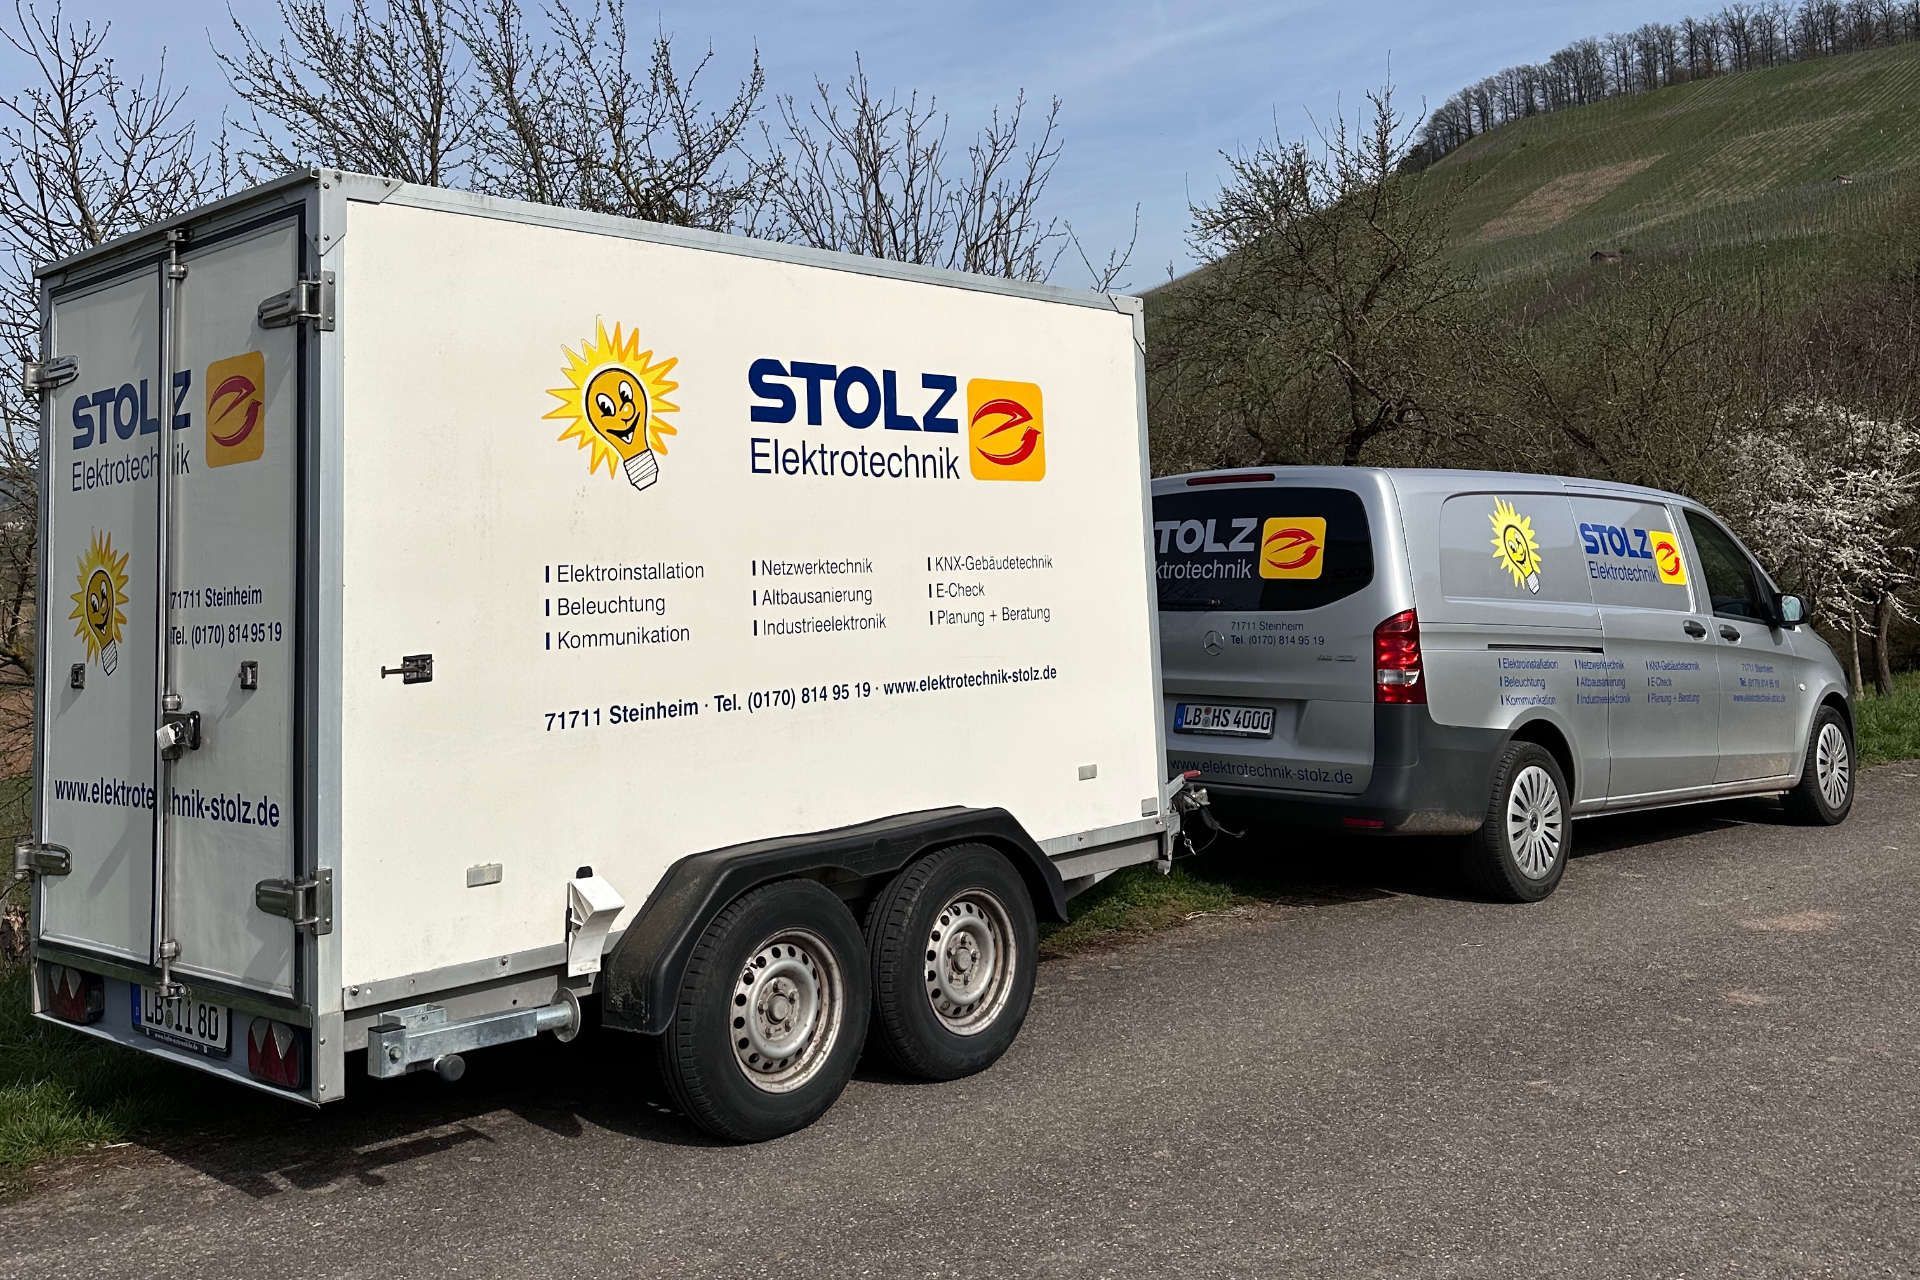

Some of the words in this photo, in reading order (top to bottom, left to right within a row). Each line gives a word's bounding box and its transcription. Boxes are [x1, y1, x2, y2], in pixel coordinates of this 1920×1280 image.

[748, 358, 959, 433] STOLZ
[72, 369, 191, 450] STOLZ
[72, 443, 190, 492] Elektrotechik
[751, 437, 960, 479] Elektrotechnik
[1154, 517, 1257, 553] TOLZ
[1580, 523, 1653, 559] STOLZ
[557, 562, 704, 583] Elektroinstallation
[762, 558, 873, 576] Netzwerktechnik
[935, 555, 1053, 572] KNX-Gebäudetechnik
[1155, 559, 1253, 579] ktrotechnik
[1588, 561, 1659, 583] Elektrotechnik
[170, 589, 201, 610] 71711
[205, 585, 262, 607] Steinheim
[762, 587, 873, 606] Altbausanierung
[936, 582, 985, 598] E-Check
[557, 595, 666, 616] Beleuchtung
[937, 609, 985, 627] Planung
[989, 610, 998, 622] +
[1002, 606, 1051, 623] Beratung
[763, 613, 887, 636] Industrieelektronik
[1259, 620, 1304, 631] Steinheim
[171, 625, 188, 645] Tel.
[191, 624, 225, 650] (0170)
[558, 625, 690, 650] Kommunikation
[1279, 635, 1296, 646] 814
[1314, 635, 1325, 646] 19
[1504, 676, 1546, 689] Beleuchtung
[544, 708, 601, 732] 71711
[609, 699, 699, 724] Steinheim
[714, 693, 741, 712] Tel.
[747, 688, 796, 713] (0170)
[801, 686, 828, 704] 814
[832, 684, 850, 700] 95
[854, 682, 871, 698] 19
[883, 665, 1057, 695] www.elektrotechnik-stolz.de
[1184, 707, 1202, 726] LB
[1211, 708, 1231, 727] HS
[1233, 710, 1271, 730] 4000
[1170, 758, 1353, 784] www.elektrotechnik-stolz.de
[55, 777, 280, 827] www.elektrotehnik-stolz.de
[145, 989, 164, 1025] LB
[198, 1003, 218, 1041] 80
